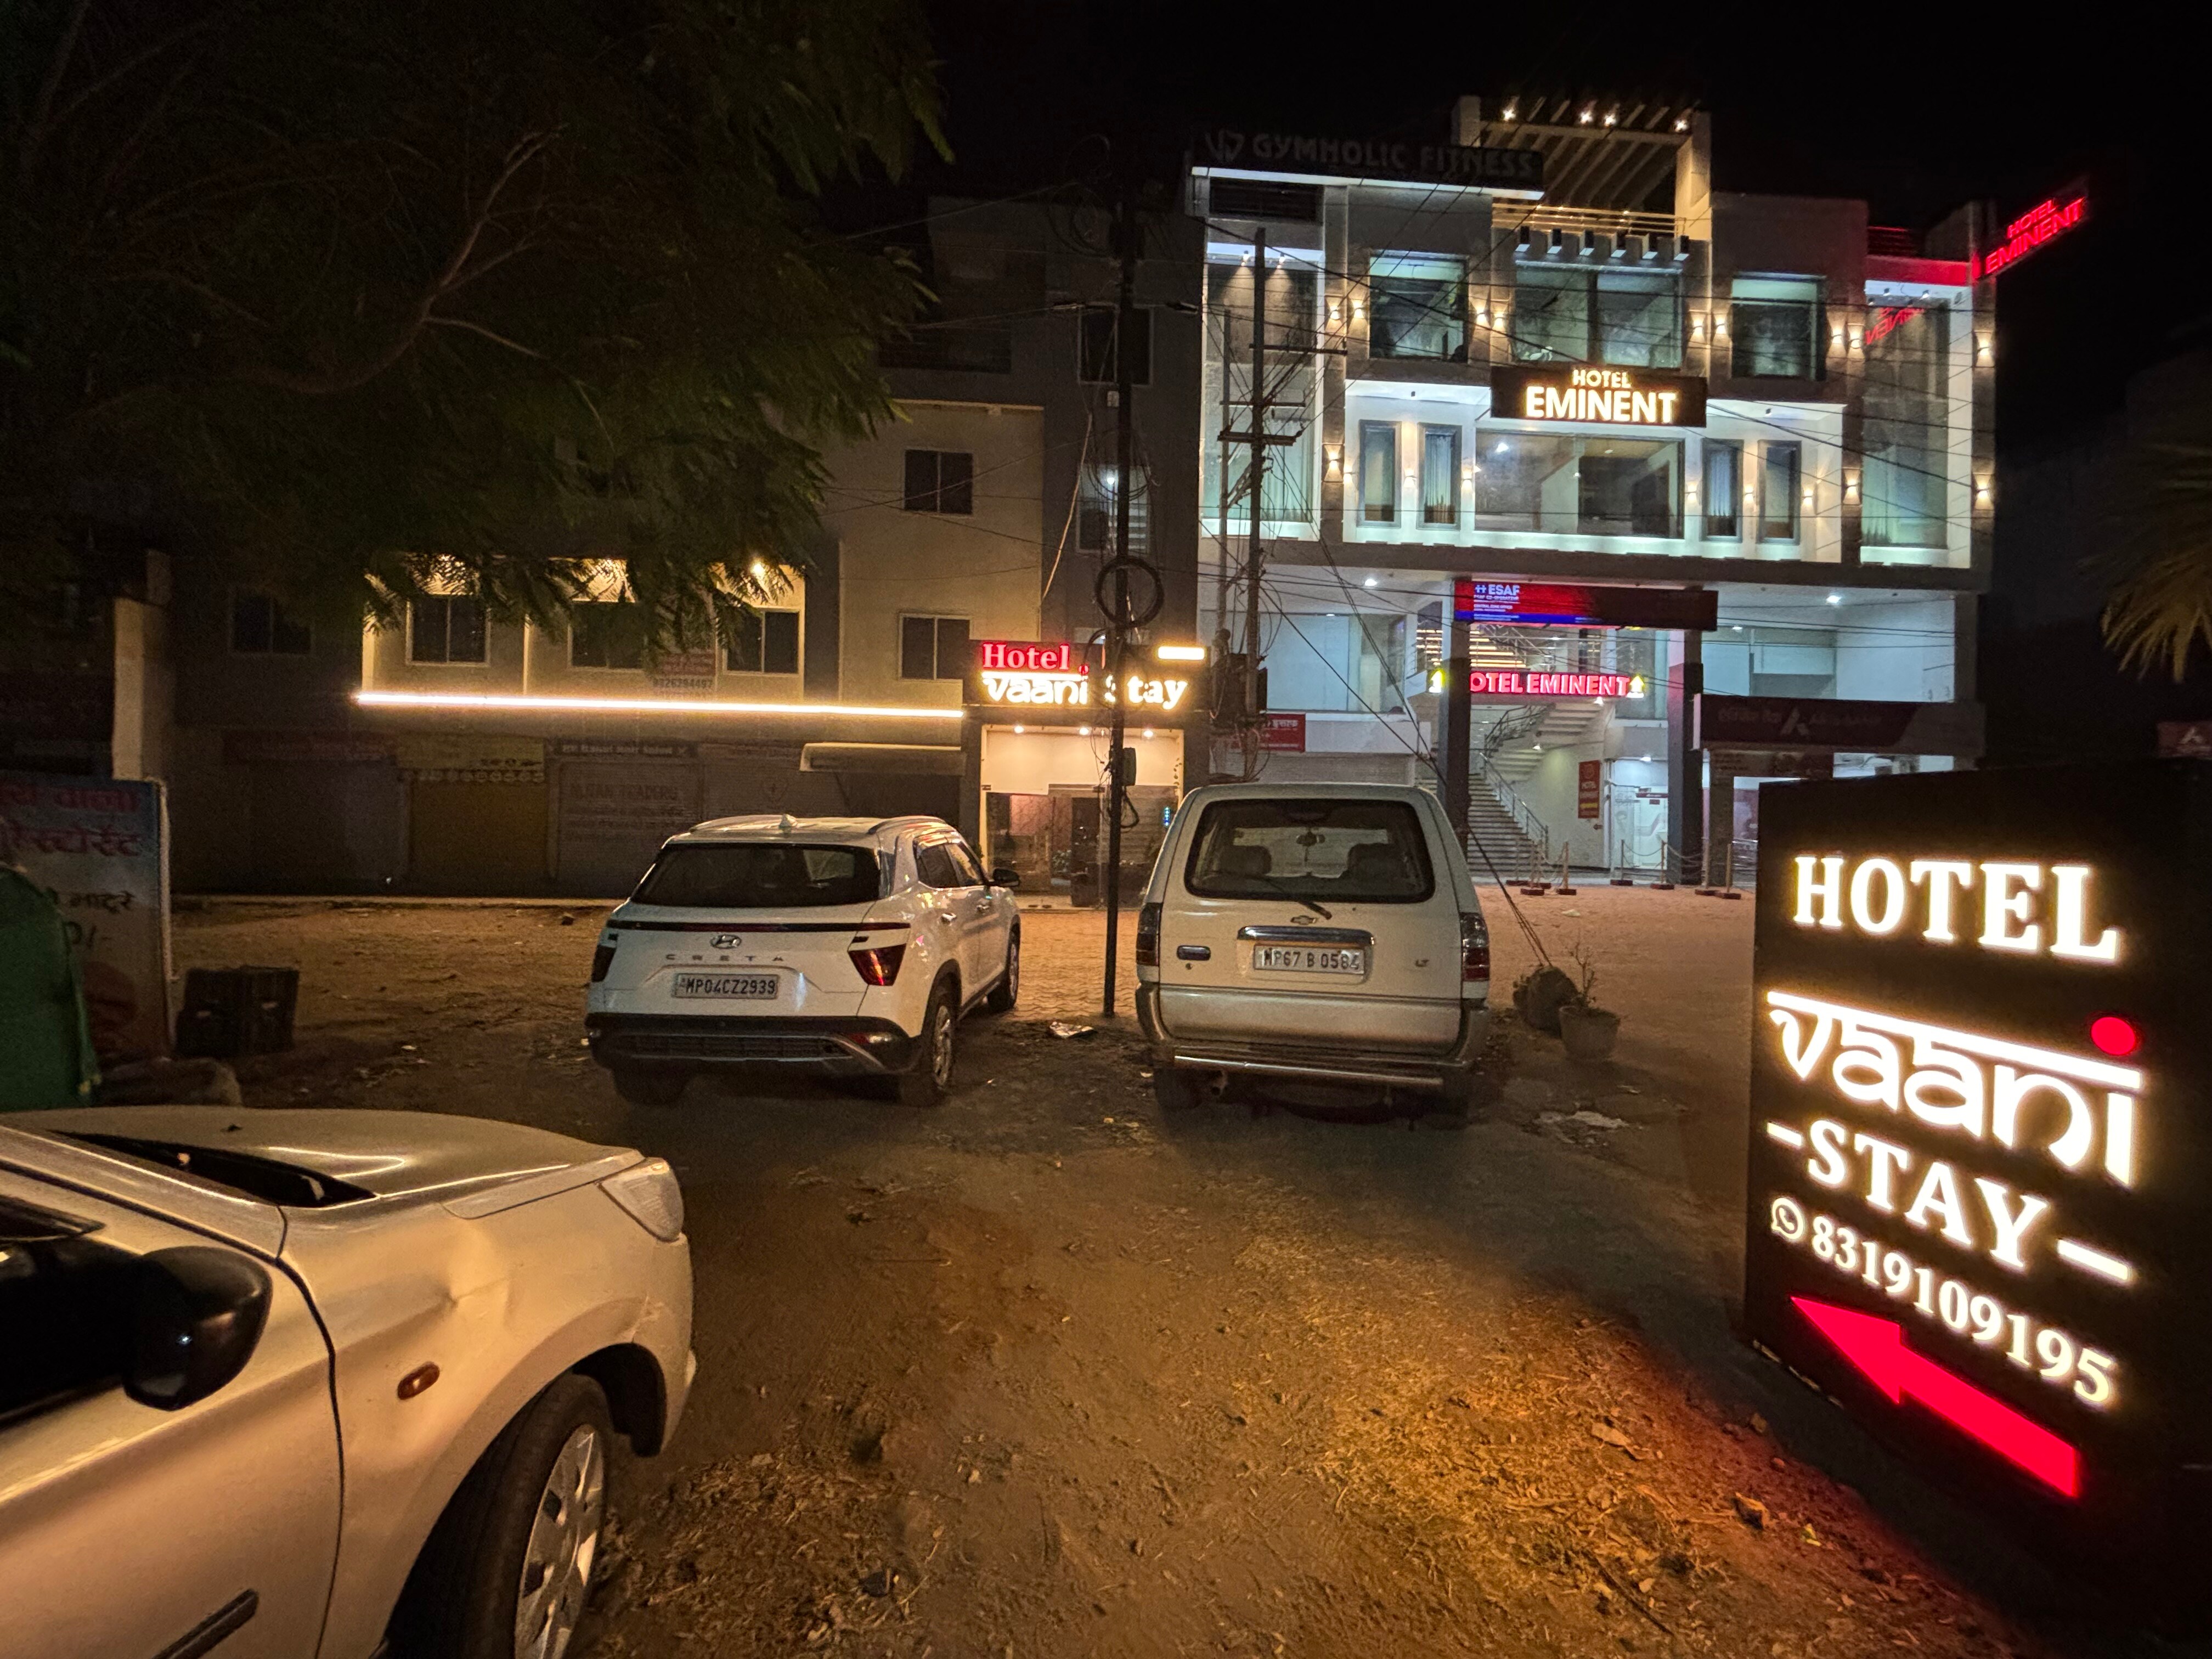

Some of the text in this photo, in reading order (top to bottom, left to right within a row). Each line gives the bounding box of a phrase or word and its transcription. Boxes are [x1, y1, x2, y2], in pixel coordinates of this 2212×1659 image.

[1251, 132, 1534, 179] GYMHOLIC FITNESS
[1984, 196, 2086, 275] EMINENT
[2006, 198, 2057, 239] HOTEL
[1572, 369, 1632, 388] HOTEL
[1525, 385, 1677, 424] EMINENT
[1488, 584, 1520, 596] ESAF
[983, 642, 1070, 671] Hotel
[1470, 672, 1630, 696] OTEL EMINENT
[1793, 856, 2120, 961] HOTEL
[665, 953, 783, 962] CRETA
[1262, 949, 1301, 967] MP67
[1307, 952, 1315, 967] B
[685, 978, 776, 995] MP04CZ2939
[1808, 1120, 2052, 1269] STAY
[1812, 1215, 2118, 1404] 8319109195
